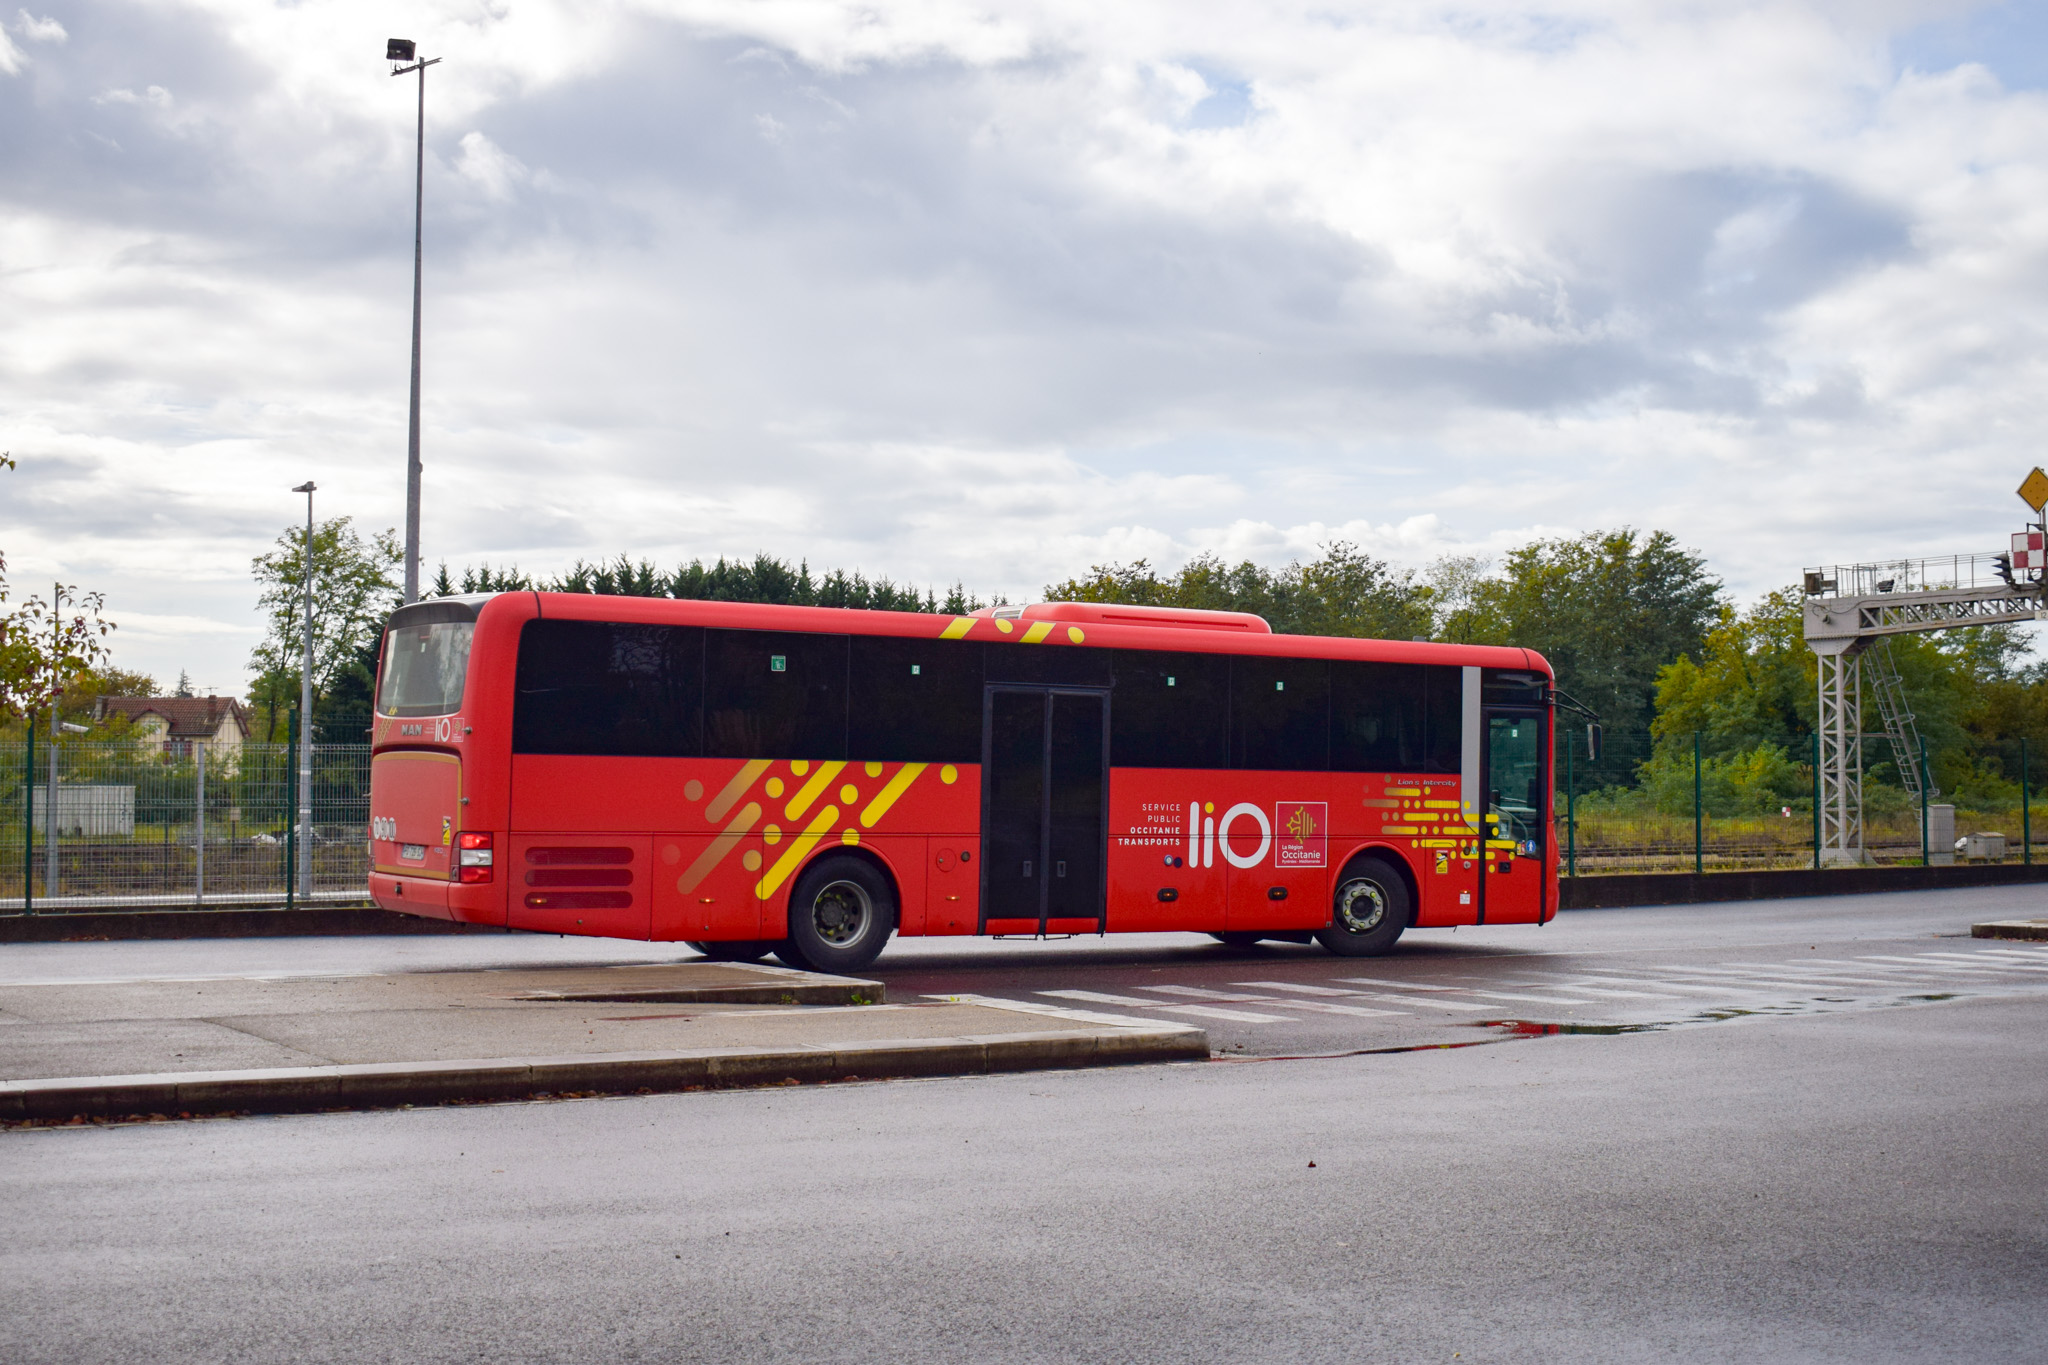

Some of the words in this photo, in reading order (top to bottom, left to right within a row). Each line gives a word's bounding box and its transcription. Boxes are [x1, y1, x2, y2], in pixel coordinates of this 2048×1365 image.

[401, 724, 423, 736] MAN
[1423, 779, 1457, 787] Intercity
[1142, 803, 1181, 812] SERVICE
[1147, 815, 1181, 823] PUBLIC
[1130, 826, 1181, 835] OCCITANIE
[1118, 838, 1181, 846] TRANSPORTS
[1281, 850, 1321, 859] Occitanie
